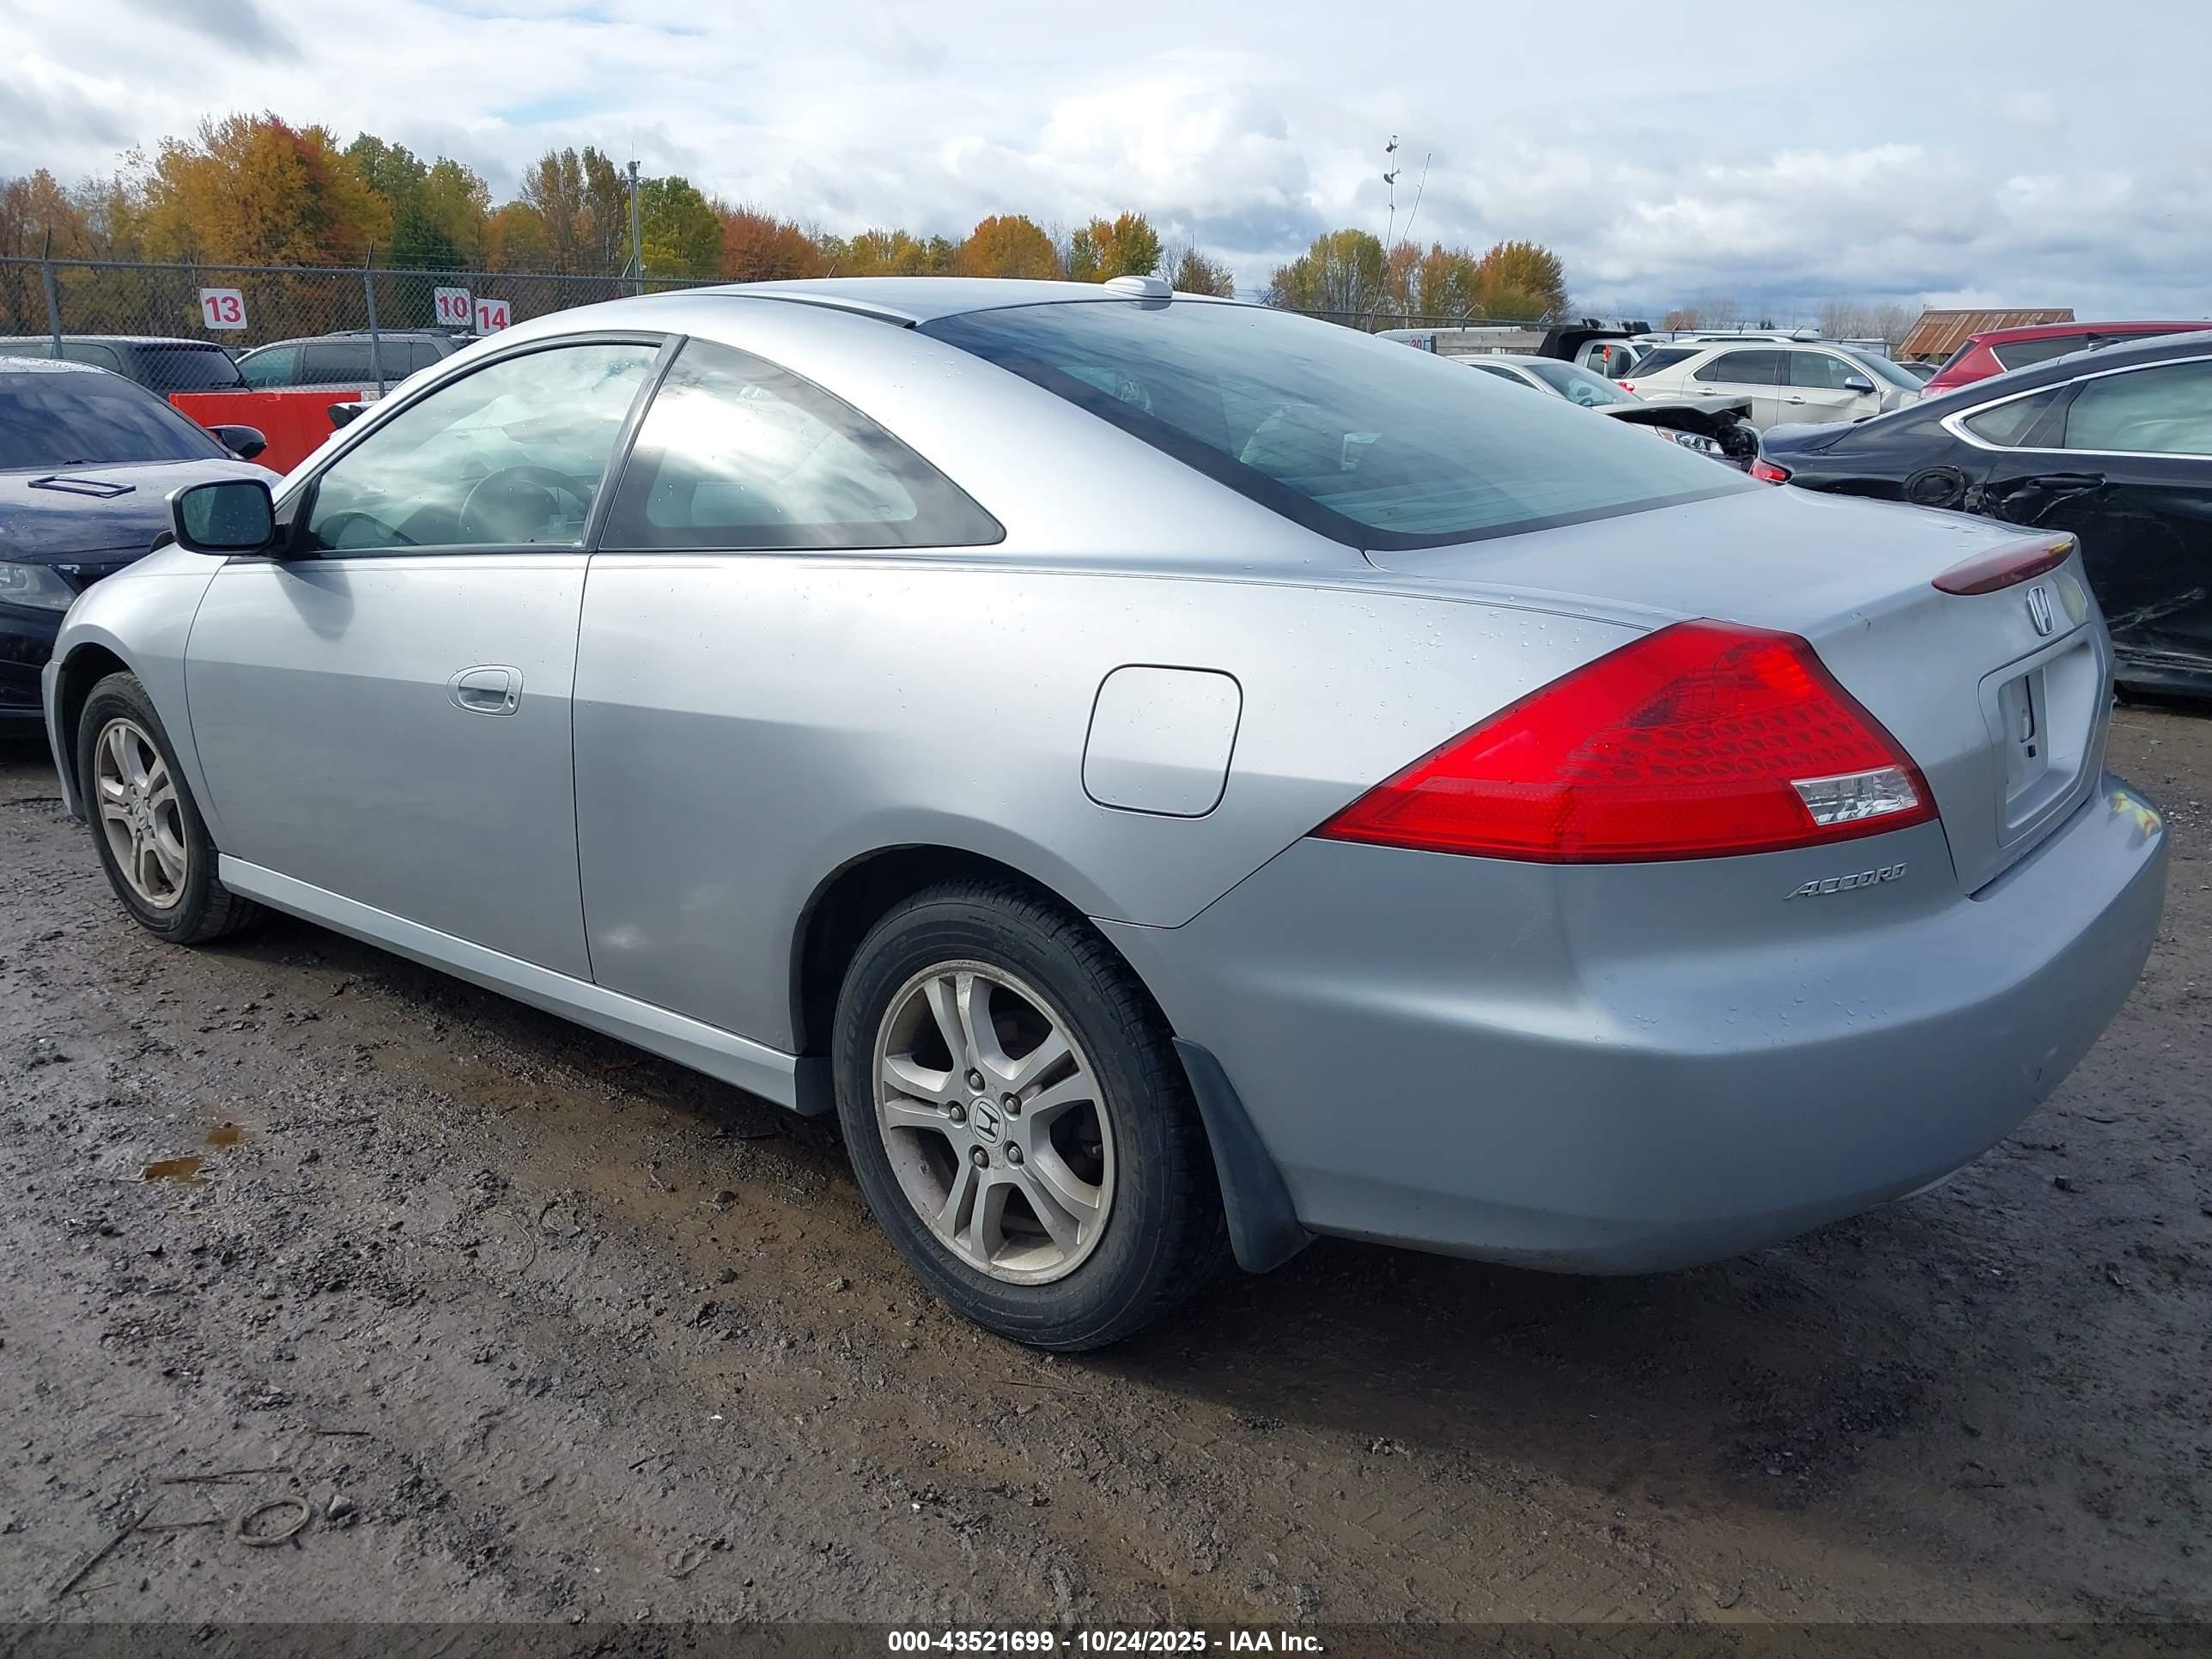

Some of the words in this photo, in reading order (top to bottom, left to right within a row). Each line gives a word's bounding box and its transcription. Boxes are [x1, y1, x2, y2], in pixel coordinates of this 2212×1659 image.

[205, 295, 241, 323] 13
[439, 295, 468, 319] 10
[478, 306, 507, 330] 14
[1784, 861, 1909, 900] ACCORD
